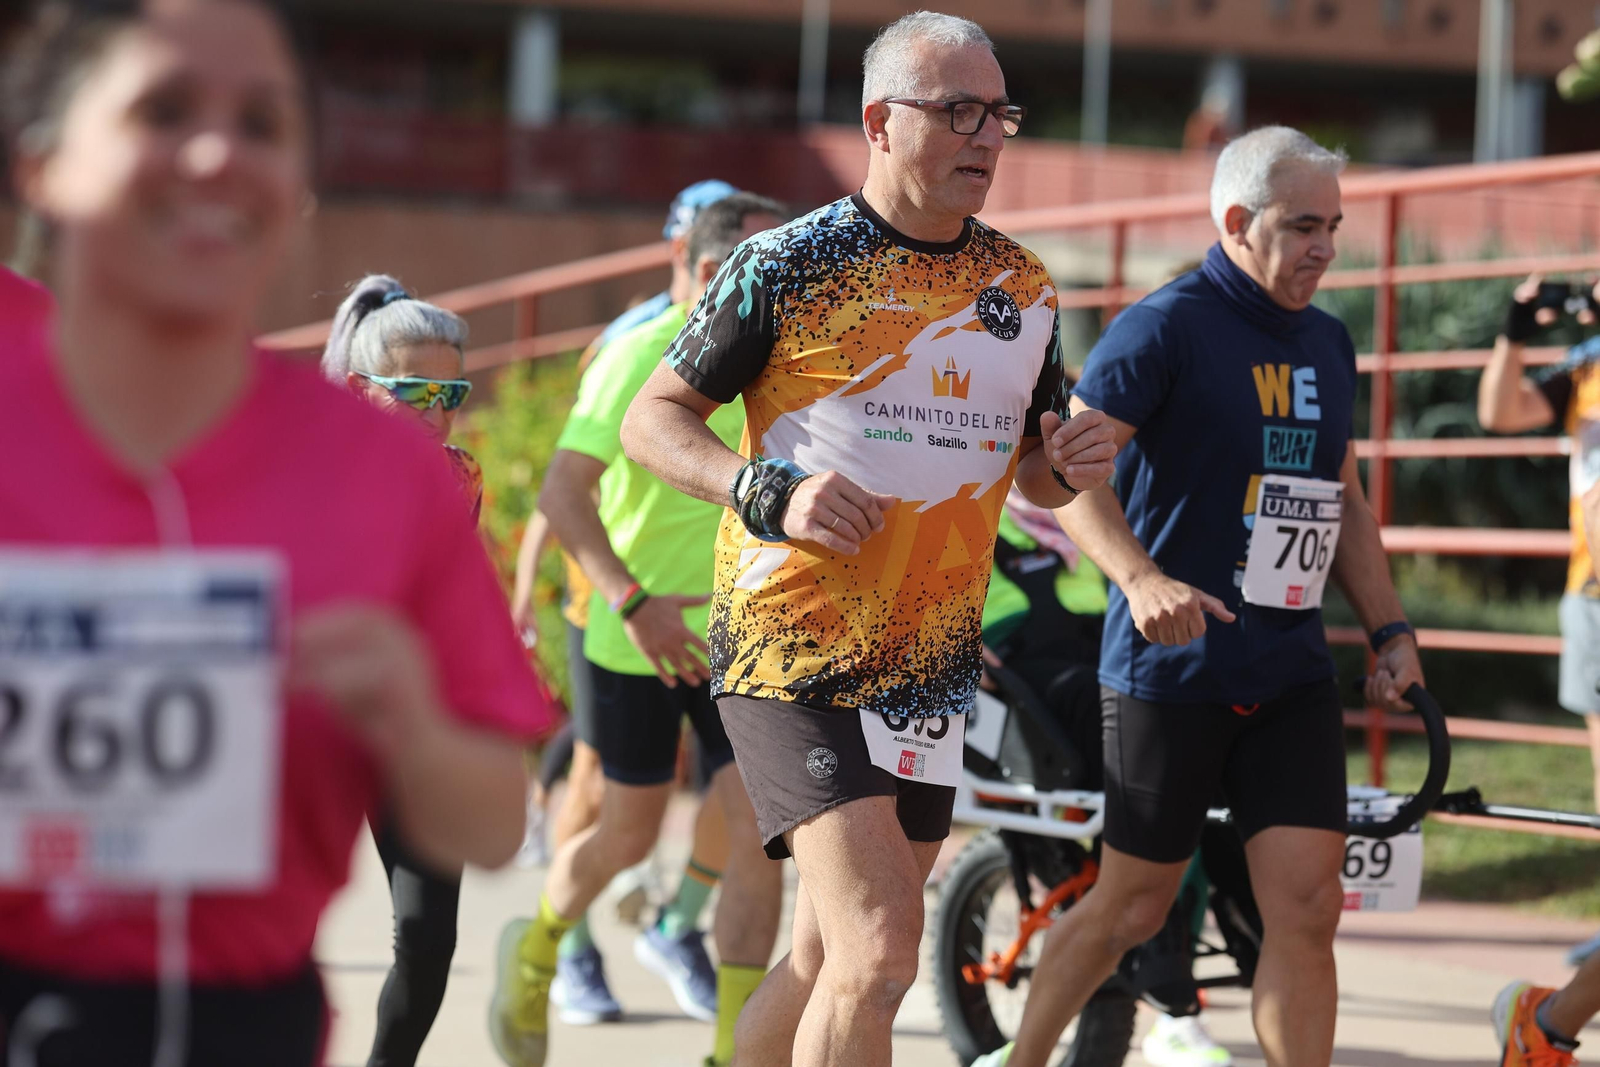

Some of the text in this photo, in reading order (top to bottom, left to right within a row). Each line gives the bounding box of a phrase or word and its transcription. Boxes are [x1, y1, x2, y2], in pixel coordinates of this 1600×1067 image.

[867, 302, 915, 313] TEAMERGY
[979, 288, 1019, 325] TRAZACAMINOS
[992, 327, 1014, 338] CLUB
[1252, 363, 1321, 420] WE
[864, 401, 954, 426] CAMINITO
[959, 412, 989, 429] DEL
[863, 427, 913, 443] sando
[927, 434, 968, 450] Salzillo
[1267, 429, 1313, 466] RUN
[1265, 496, 1313, 519] UMA
[1273, 525, 1332, 574] 706
[1342, 840, 1393, 880] 69
